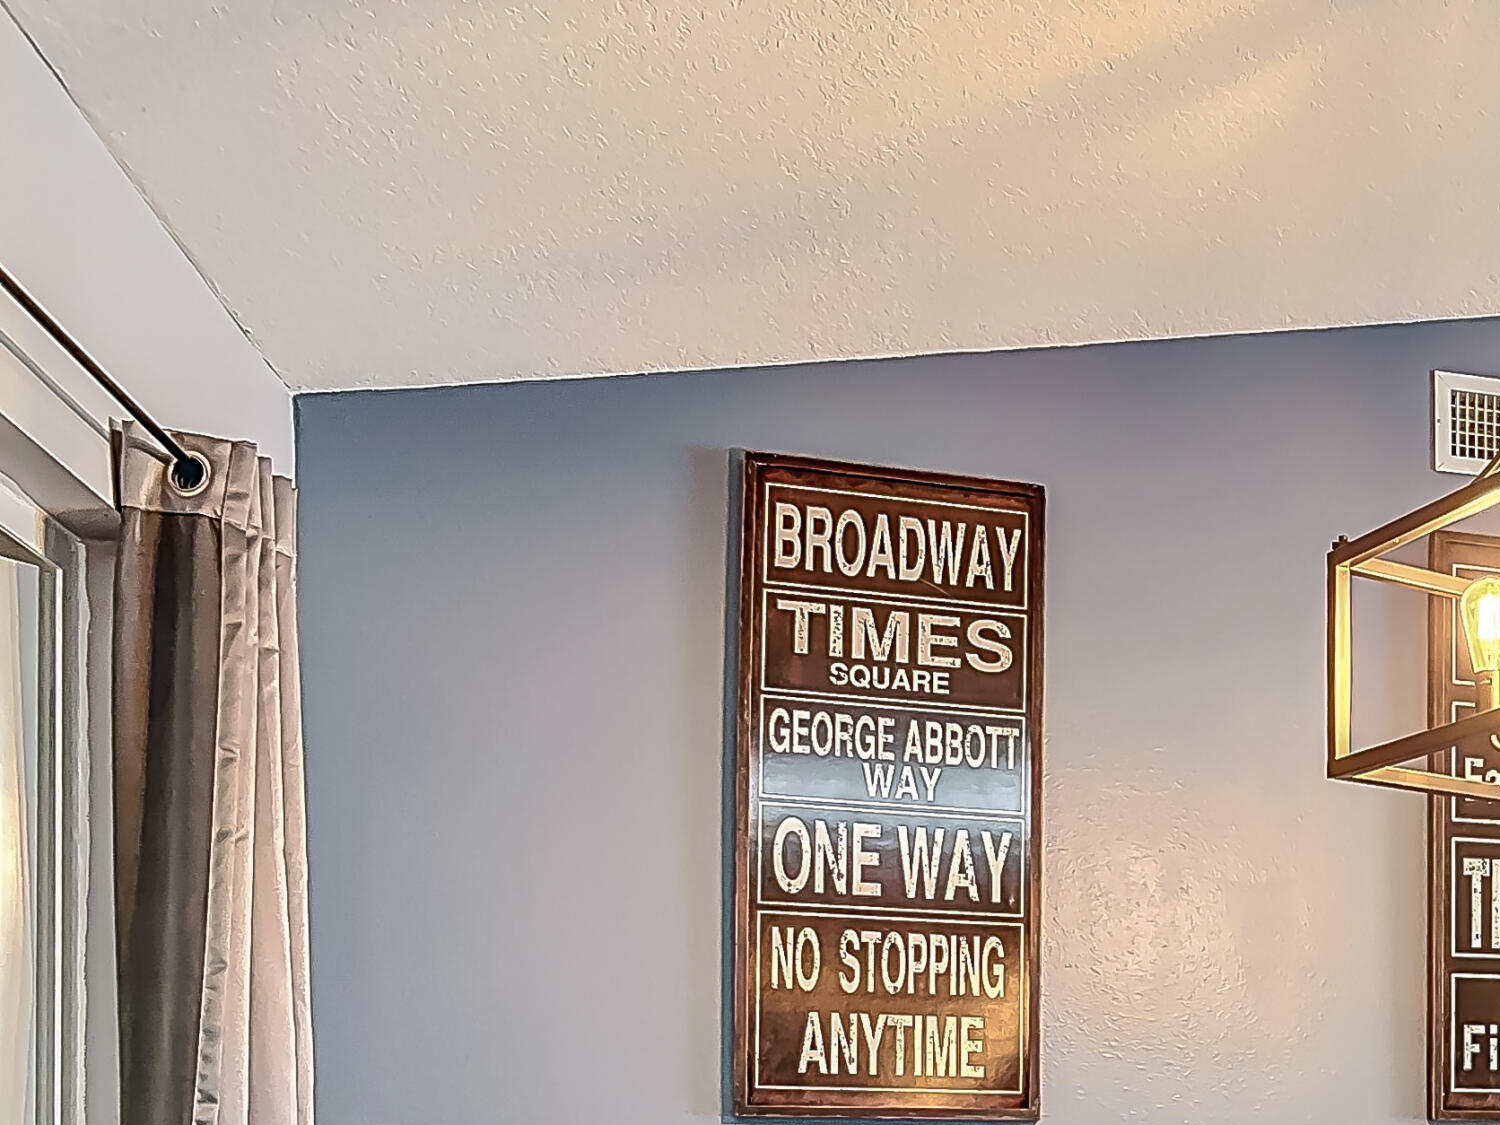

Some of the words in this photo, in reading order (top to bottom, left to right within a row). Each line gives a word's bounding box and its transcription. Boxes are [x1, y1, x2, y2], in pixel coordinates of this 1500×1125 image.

[774, 502, 1022, 592] BROADWAY
[777, 599, 1013, 673] TIMES
[829, 662, 950, 695] SQUARE
[769, 708, 896, 762] GEORGE
[904, 719, 1020, 770] ABBOTT
[862, 762, 942, 802] WAY
[773, 816, 882, 897] ONE
[897, 825, 1012, 903] WAY
[771, 926, 821, 992] NO
[839, 929, 1005, 999] STOPPING
[798, 1011, 985, 1078] ANYTIME
